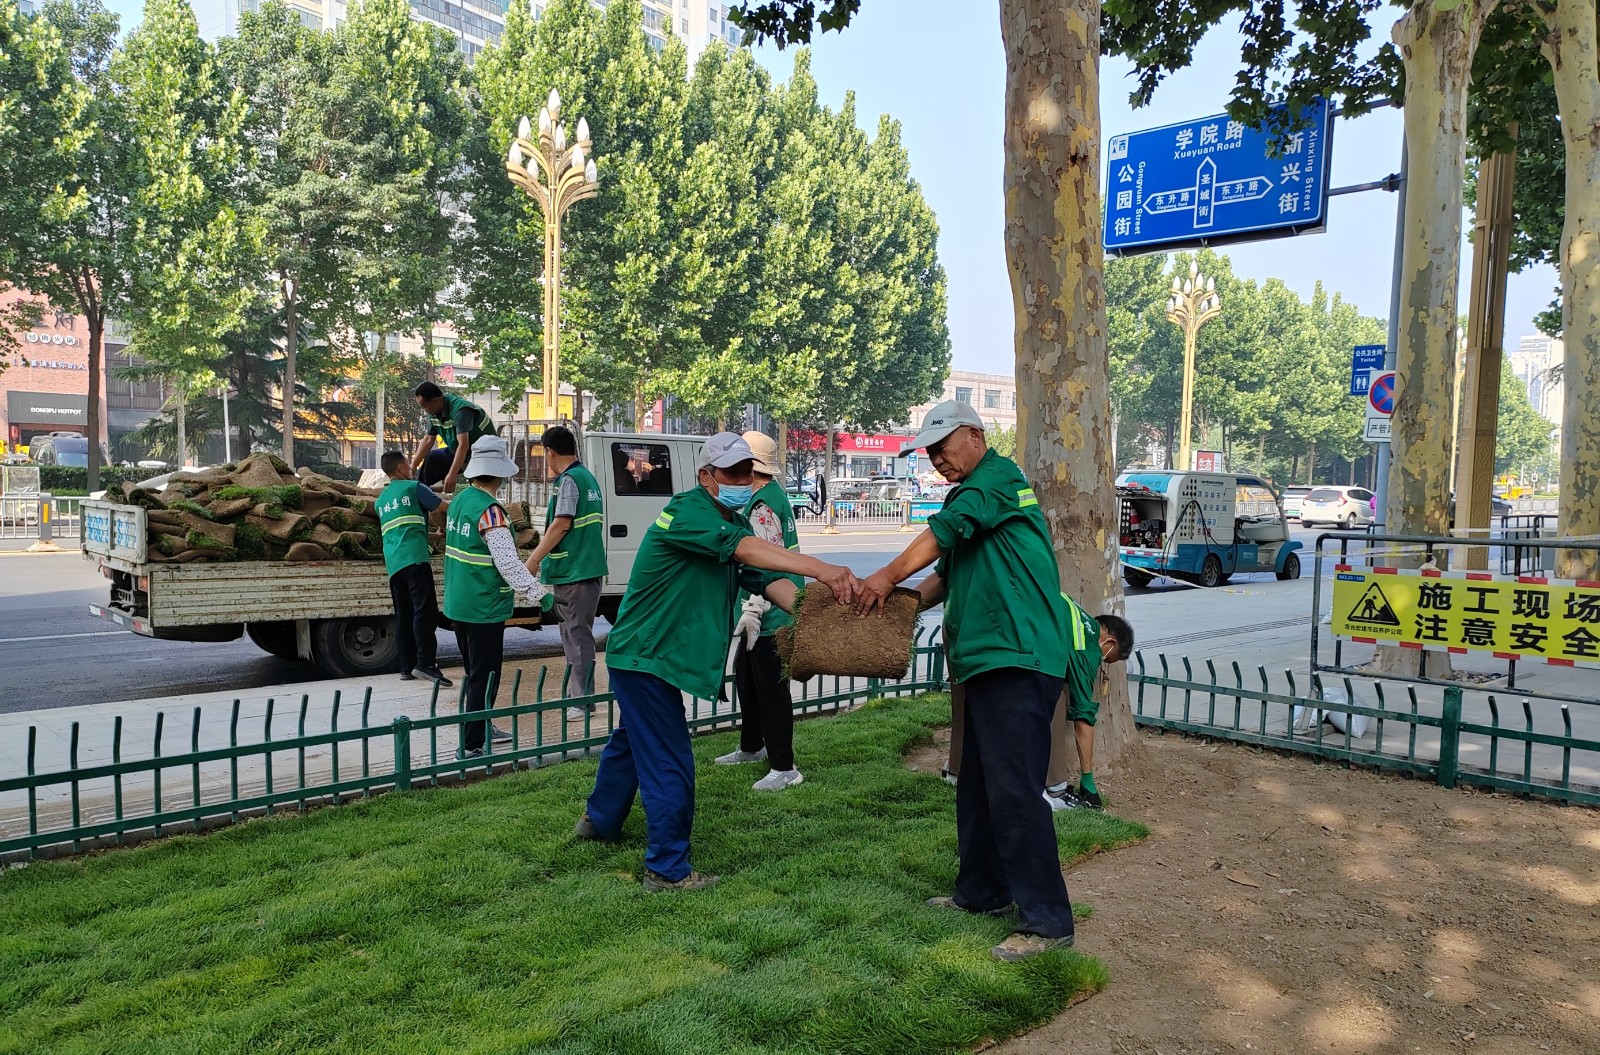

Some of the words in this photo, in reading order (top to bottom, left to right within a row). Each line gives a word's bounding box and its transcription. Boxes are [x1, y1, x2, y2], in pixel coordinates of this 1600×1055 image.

[1119, 139, 1127, 151] 西
[1175, 120, 1245, 150] 学院路
[1174, 146, 1214, 160] Xueyuan
[1217, 139, 1242, 151] Road
[1305, 129, 1318, 172] Xinxing
[1136, 161, 1146, 205] Gongyuan
[1198, 173, 1211, 217] 圣城街
[1221, 180, 1259, 196] 东升路
[1303, 177, 1314, 211] Street
[1114, 163, 1135, 237] 公园街
[1155, 191, 1190, 206] 东升路
[1134, 208, 1143, 235] Street
[27, 333, 75, 345] 经典火锅
[1355, 348, 1383, 357] 公共卫生间
[30, 406, 57, 414] DONGFU
[1417, 582, 1600, 624] 施工现场
[1414, 612, 1600, 658] 注意安全
